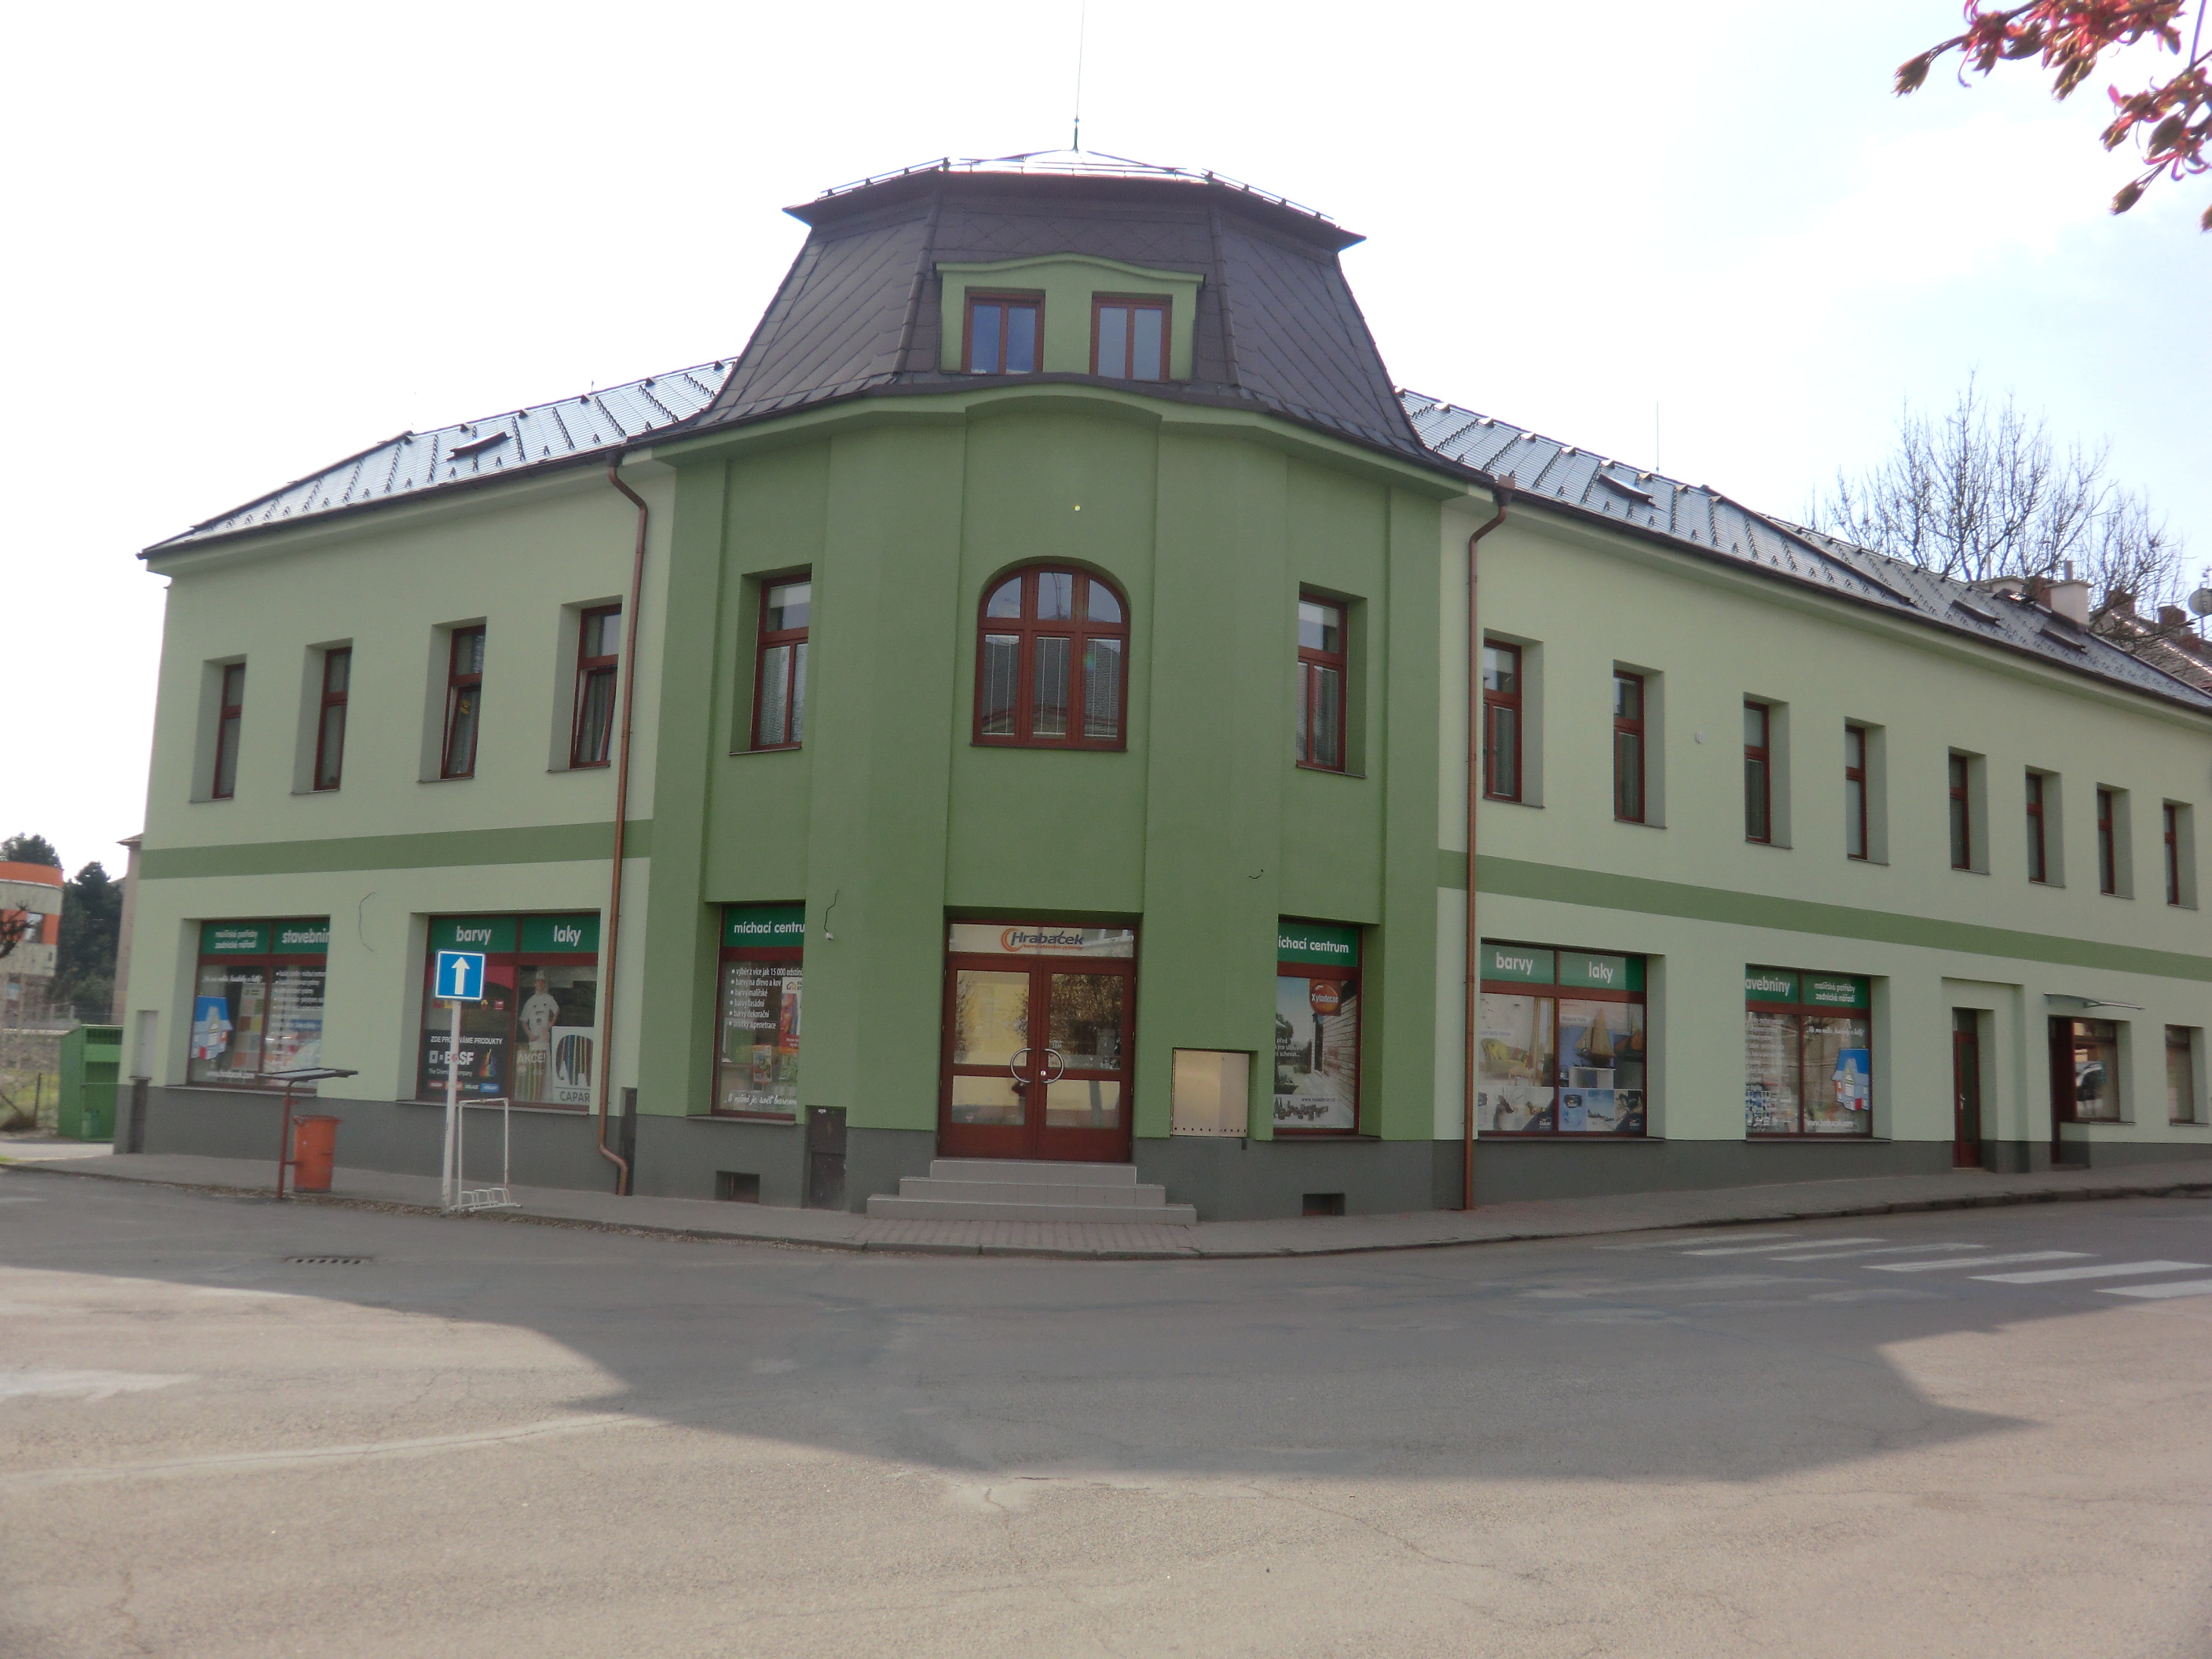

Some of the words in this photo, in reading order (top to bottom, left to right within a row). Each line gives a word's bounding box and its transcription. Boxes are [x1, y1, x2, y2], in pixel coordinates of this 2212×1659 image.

[456, 925, 492, 945] barvy
[734, 921, 771, 933] míchací
[554, 925, 581, 947] laky
[1309, 941, 1349, 953] centrum
[1496, 951, 1533, 976] barvy
[1588, 961, 1613, 984] laky
[735, 978, 748, 987] barvy
[444, 1051, 474, 1065] BSF
